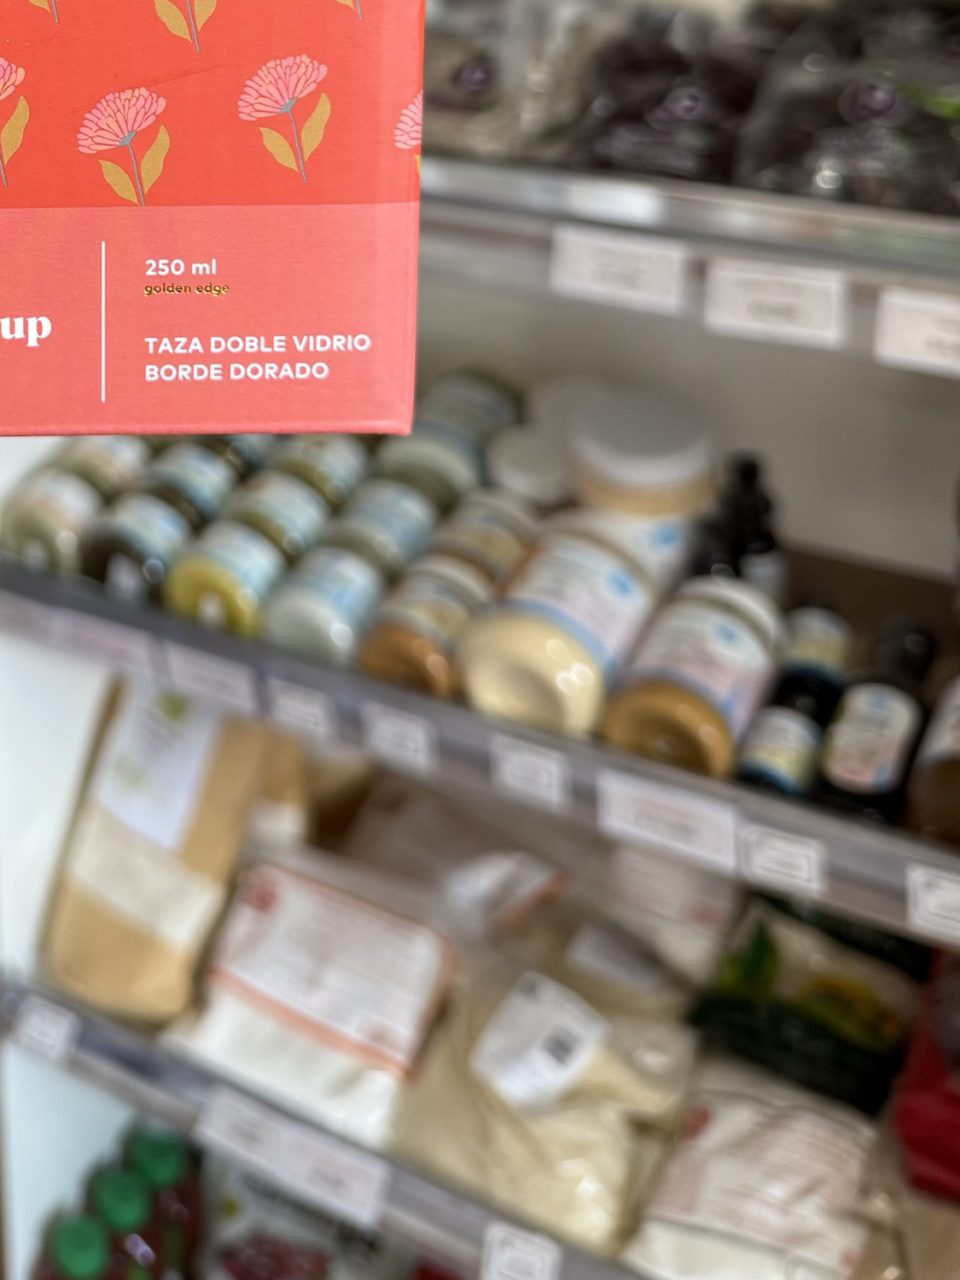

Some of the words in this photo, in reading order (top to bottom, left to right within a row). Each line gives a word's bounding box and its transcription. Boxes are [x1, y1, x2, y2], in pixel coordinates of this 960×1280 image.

[145, 258, 185, 276] 250
[191, 258, 217, 275] ml
[144, 282, 192, 296] golden
[196, 282, 230, 296] edge
[144, 336, 204, 355] TAZA
[210, 335, 287, 354] DOBLE
[292, 333, 372, 353] VIDRIO
[145, 363, 223, 382] BORDE
[229, 361, 330, 381] DORADO
